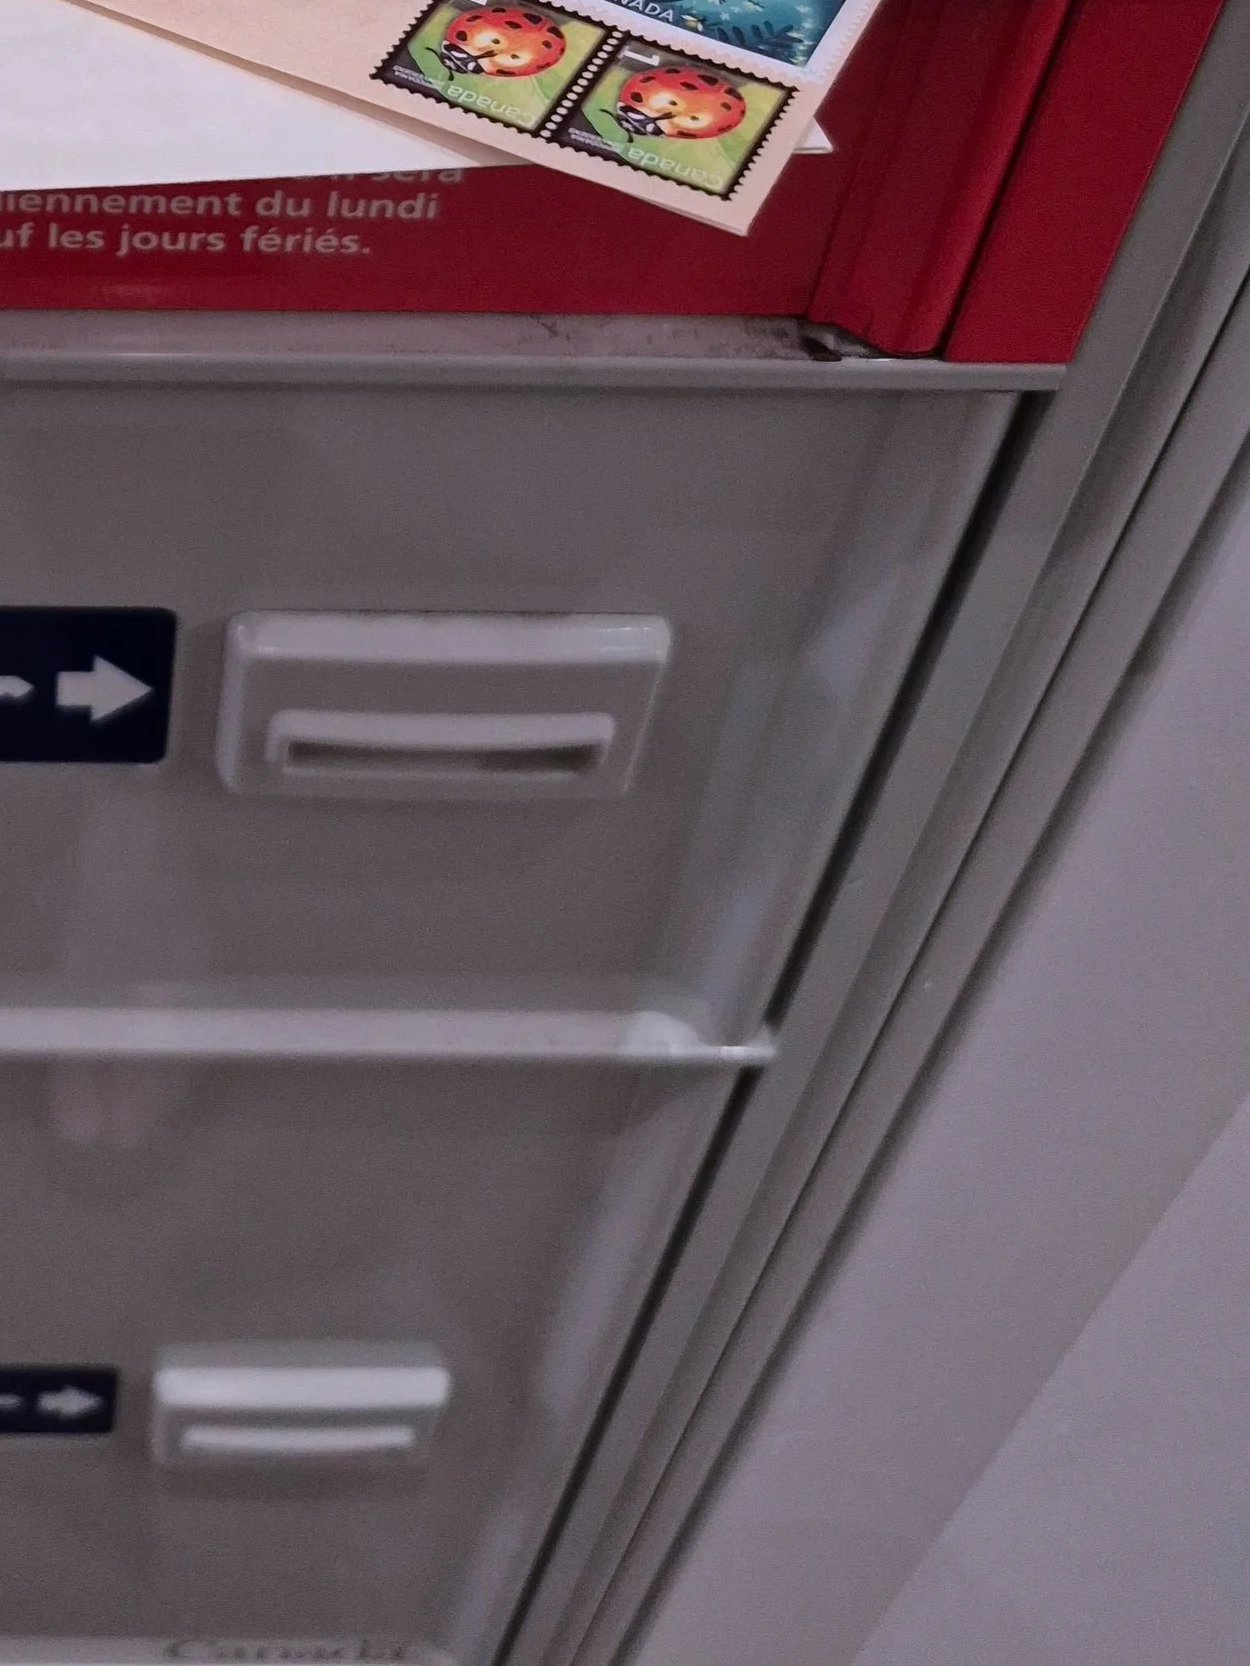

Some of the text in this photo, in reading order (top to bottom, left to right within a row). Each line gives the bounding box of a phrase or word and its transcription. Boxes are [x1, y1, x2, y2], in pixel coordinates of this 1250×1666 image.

[446, 84, 537, 127] Canada
[627, 142, 725, 190] Canada
[255, 189, 312, 217] du
[326, 190, 440, 220] lundi
[49, 222, 105, 250] les
[115, 223, 225, 258] jours
[240, 224, 372, 255] fériés.
